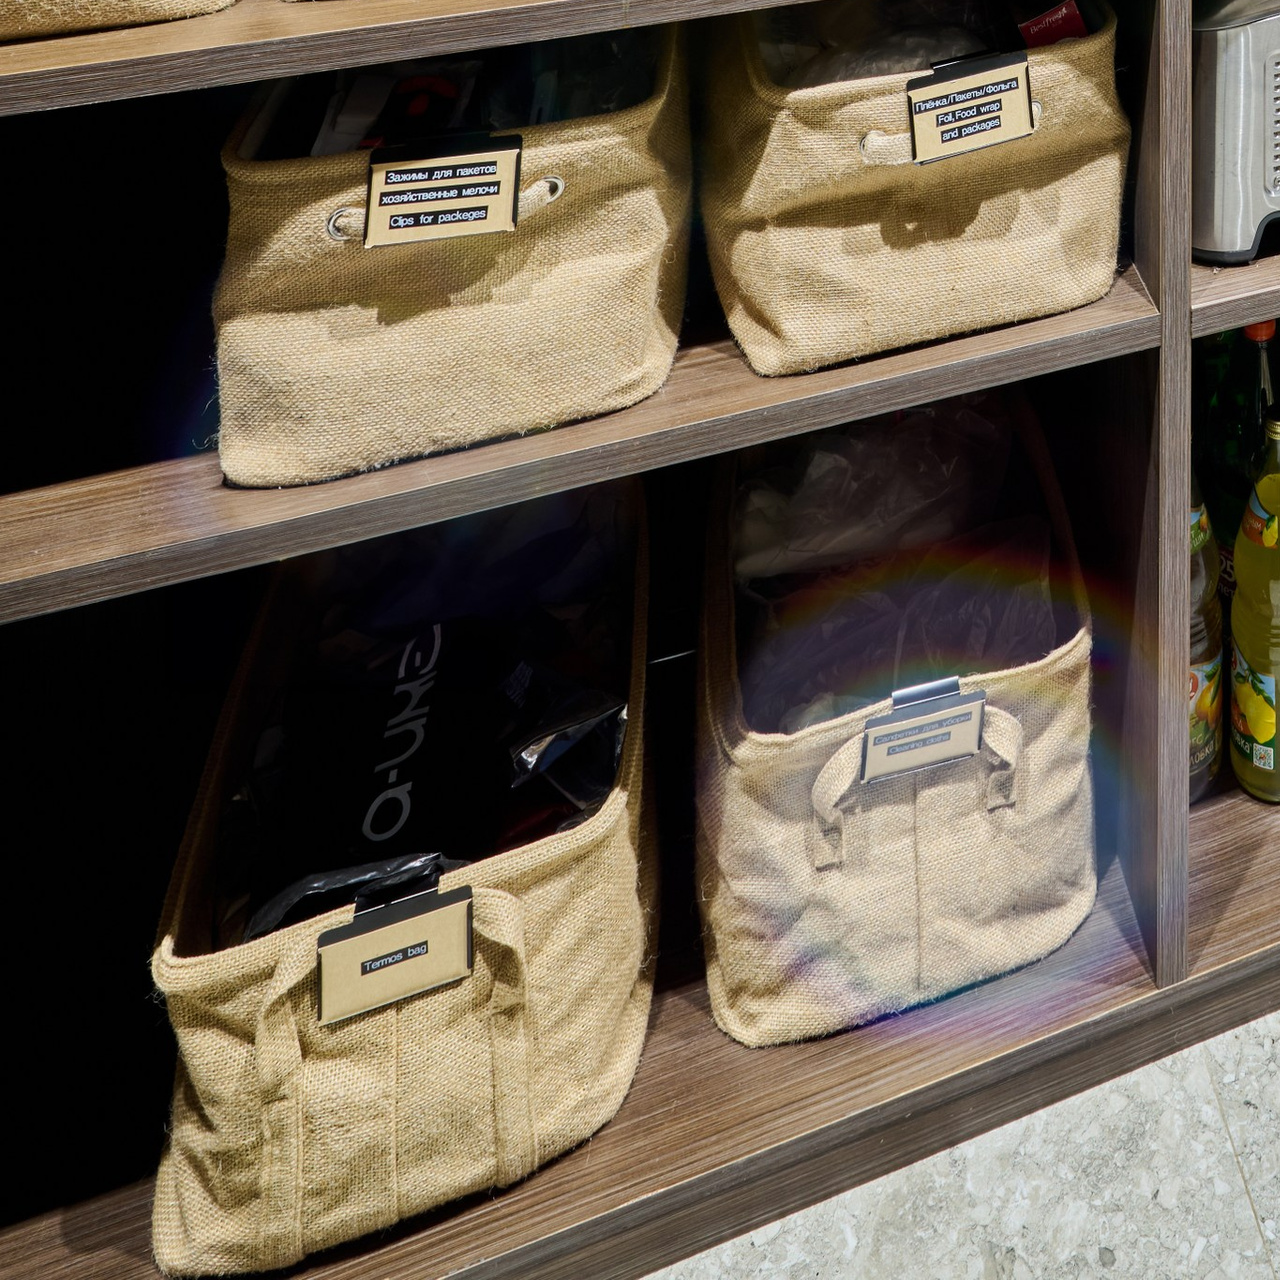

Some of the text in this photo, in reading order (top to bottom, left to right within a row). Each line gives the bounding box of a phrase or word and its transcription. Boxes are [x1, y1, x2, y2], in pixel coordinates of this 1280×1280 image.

[915, 80, 1018, 113] Плёнка/Пакеты/Фольга
[955, 107, 977, 120] Food
[980, 101, 1000, 113] wrap
[942, 117, 1000, 141] and packages
[387, 164, 497, 183] Зажимы для пакетов
[381, 184, 498, 205] хозяйственные мелочи
[390, 209, 486, 228] Clips for packeges
[875, 714, 971, 745] Салфетки для уборки
[889, 741, 923, 754] Cleaning
[364, 944, 427, 971] Termos bag
